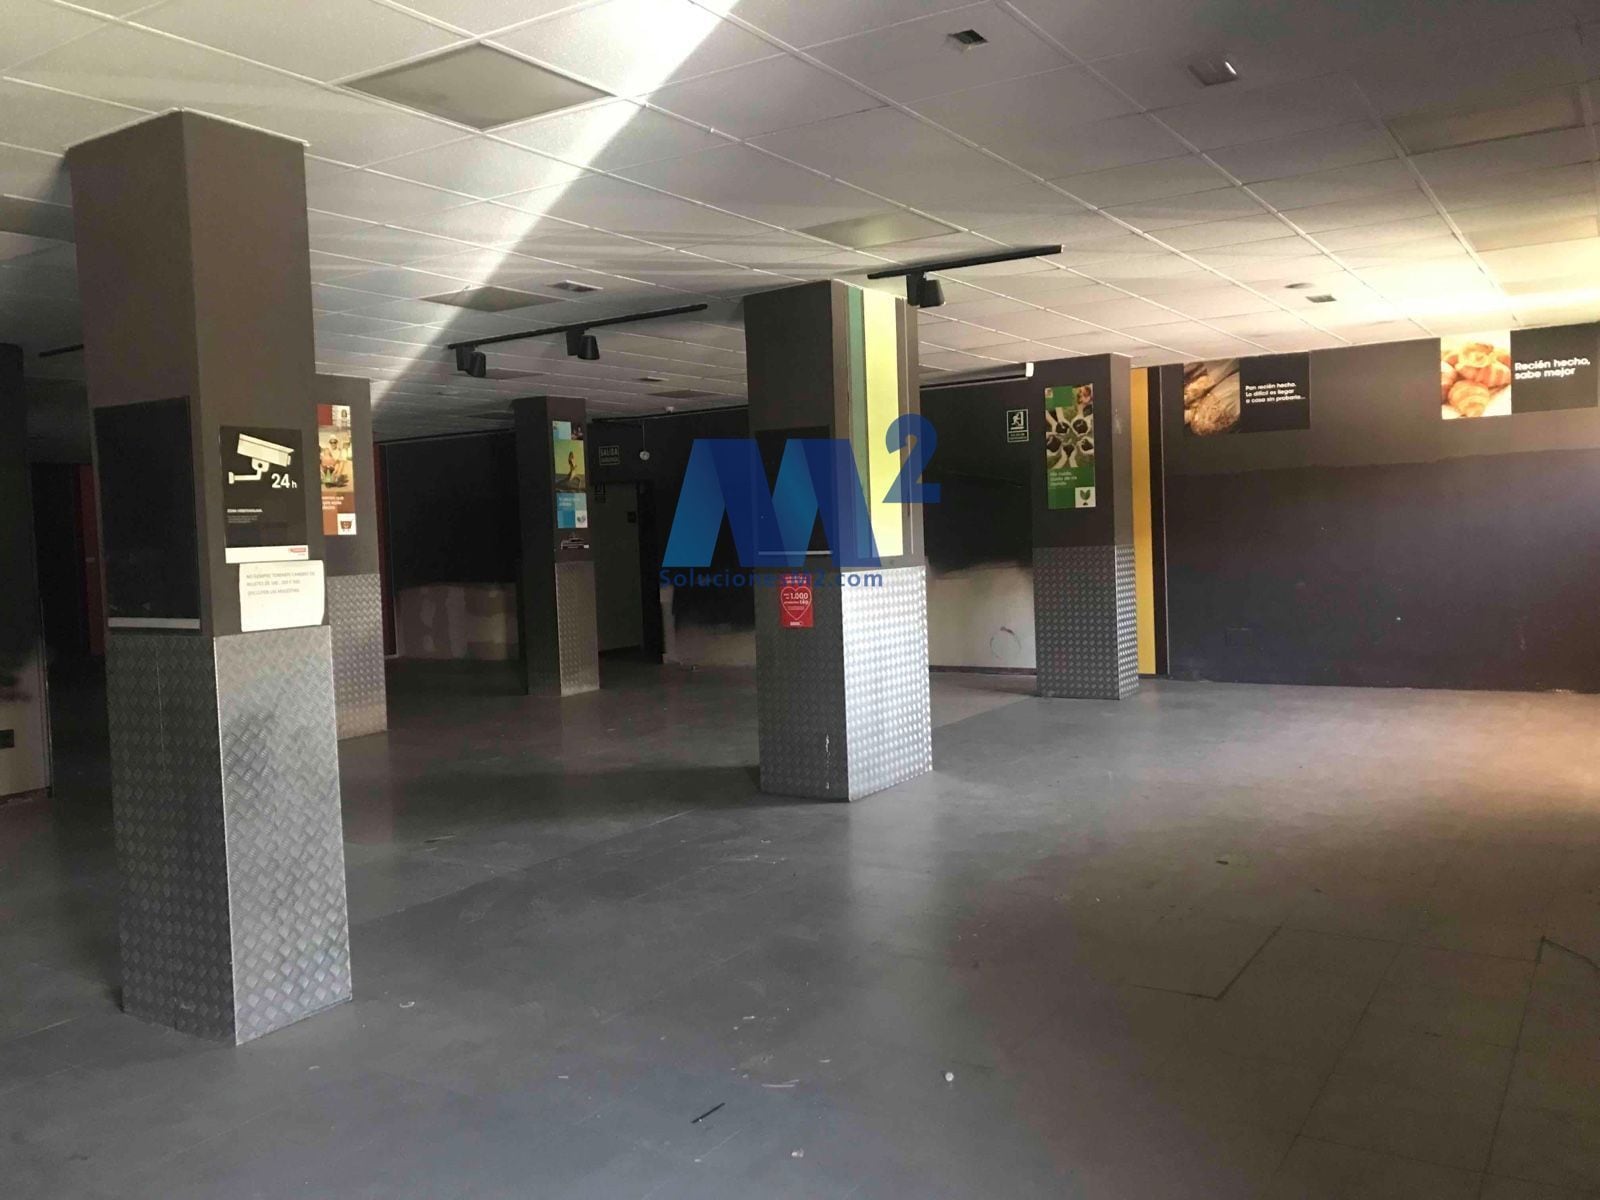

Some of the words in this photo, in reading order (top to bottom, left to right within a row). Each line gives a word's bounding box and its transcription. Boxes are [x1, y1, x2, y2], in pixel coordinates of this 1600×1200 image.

[1514, 360, 1550, 371] Recién
[1514, 370, 1541, 380] sabe
[1544, 367, 1576, 378] mejor
